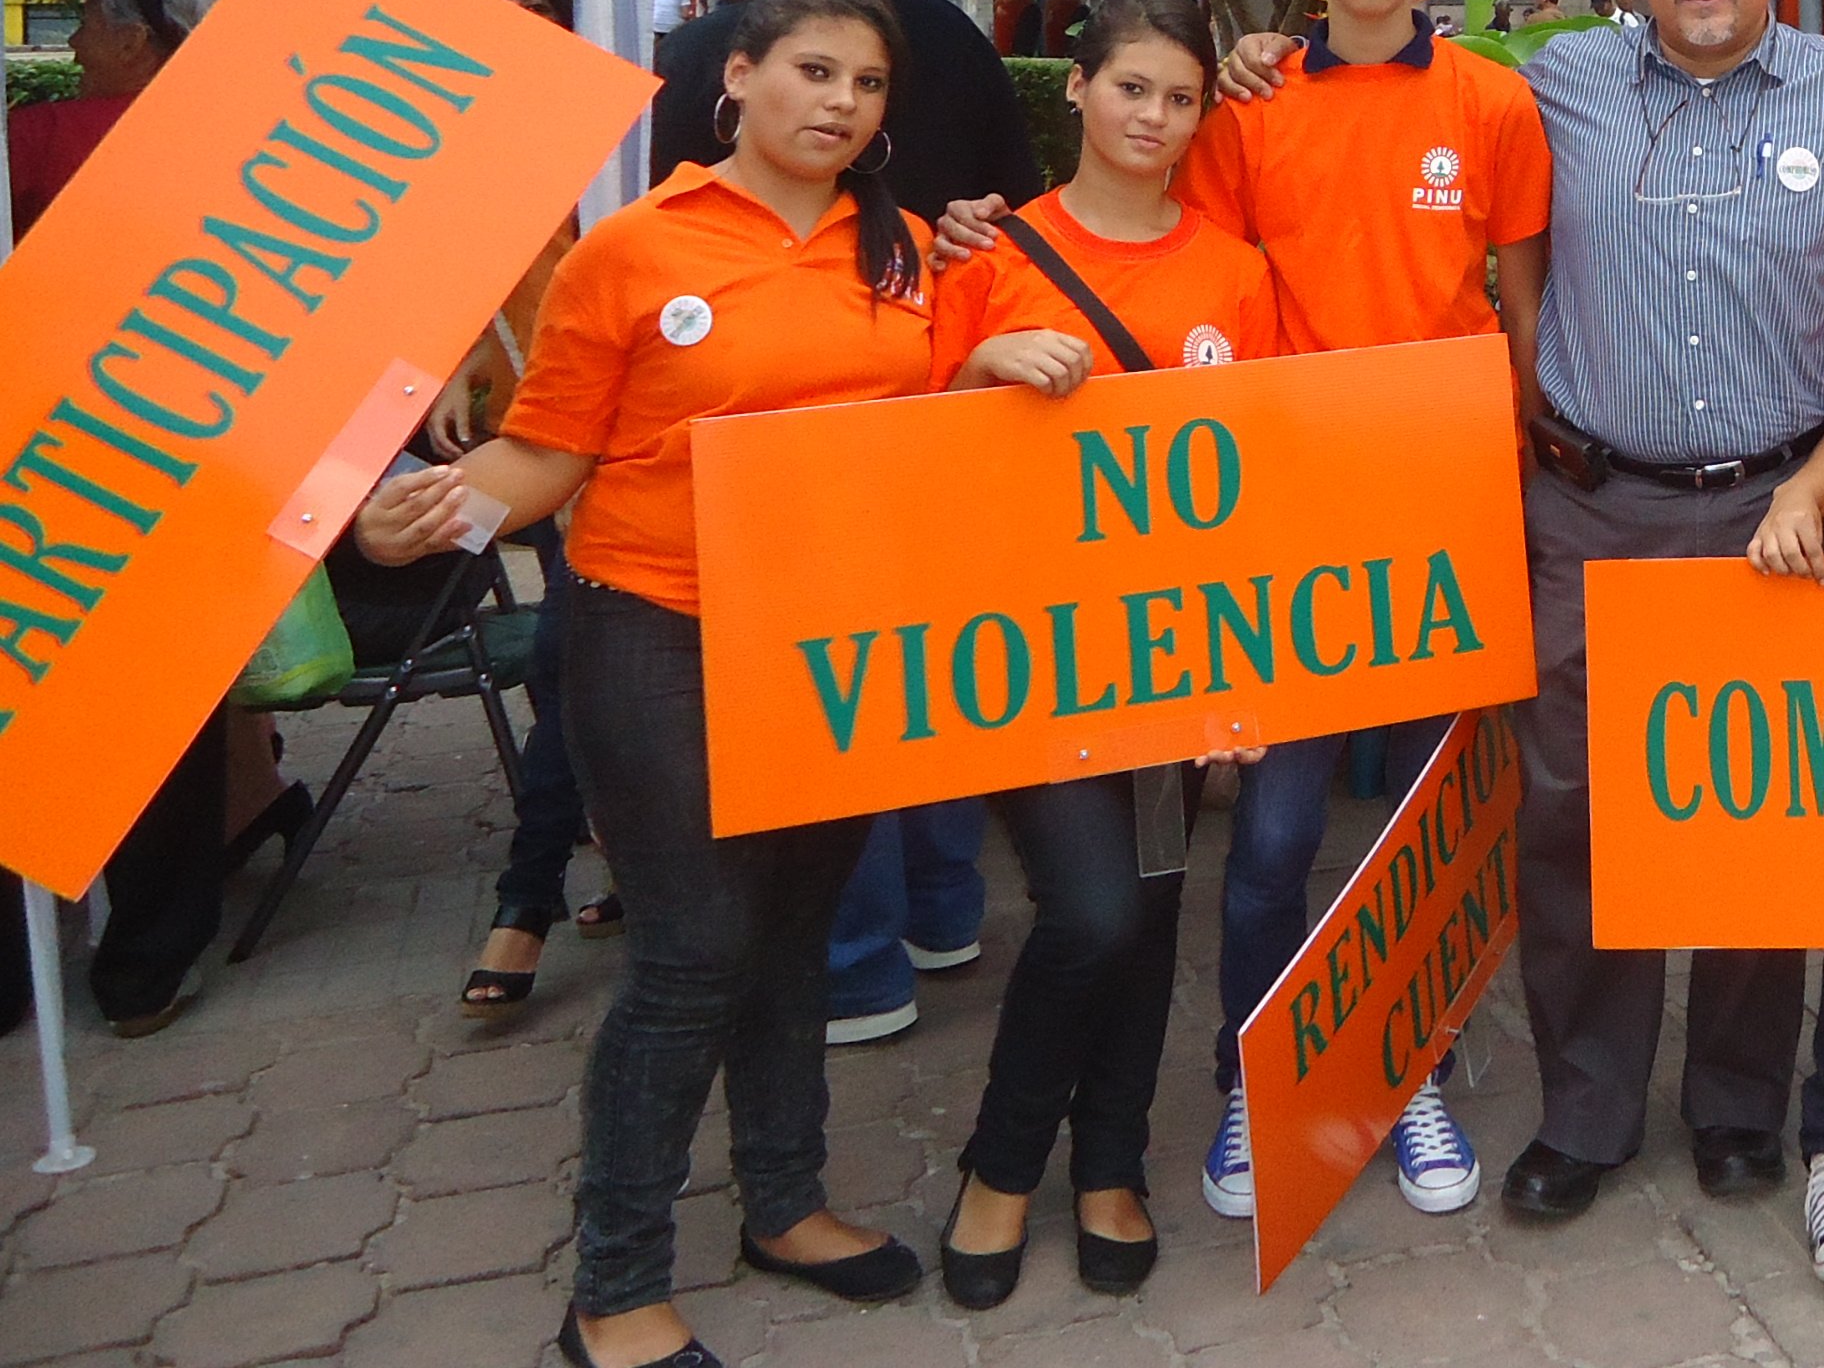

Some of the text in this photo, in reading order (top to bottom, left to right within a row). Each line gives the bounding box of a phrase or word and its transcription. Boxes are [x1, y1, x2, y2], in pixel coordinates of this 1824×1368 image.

[1411, 187, 1463, 204] PINU
[0, 5, 495, 735] ARTICIPACIÓN
[1073, 418, 1242, 542] NO
[797, 549, 1484, 753] VIOLENCIA
